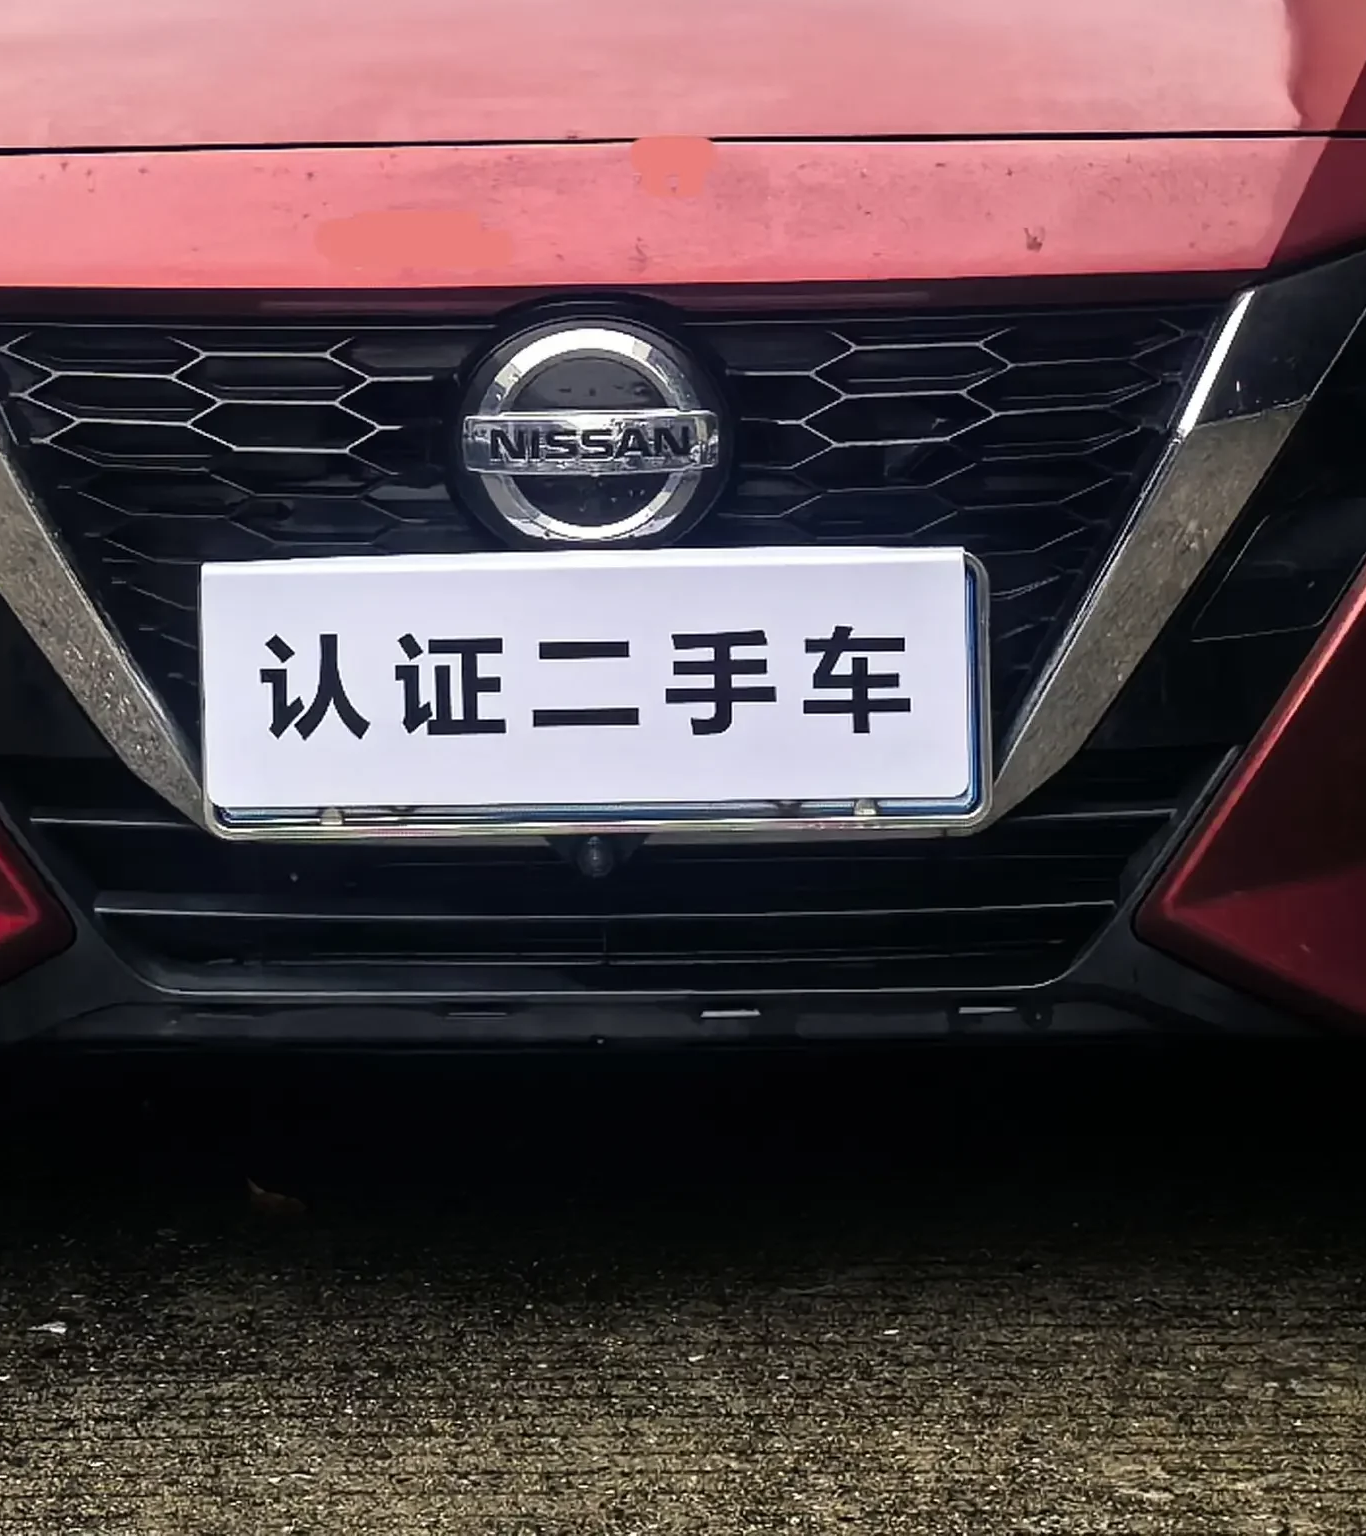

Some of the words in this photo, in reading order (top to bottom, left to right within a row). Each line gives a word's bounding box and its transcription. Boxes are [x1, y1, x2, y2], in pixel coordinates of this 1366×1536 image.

[490, 427, 691, 460] NISSAN
[258, 625, 913, 742] 认证二手车
